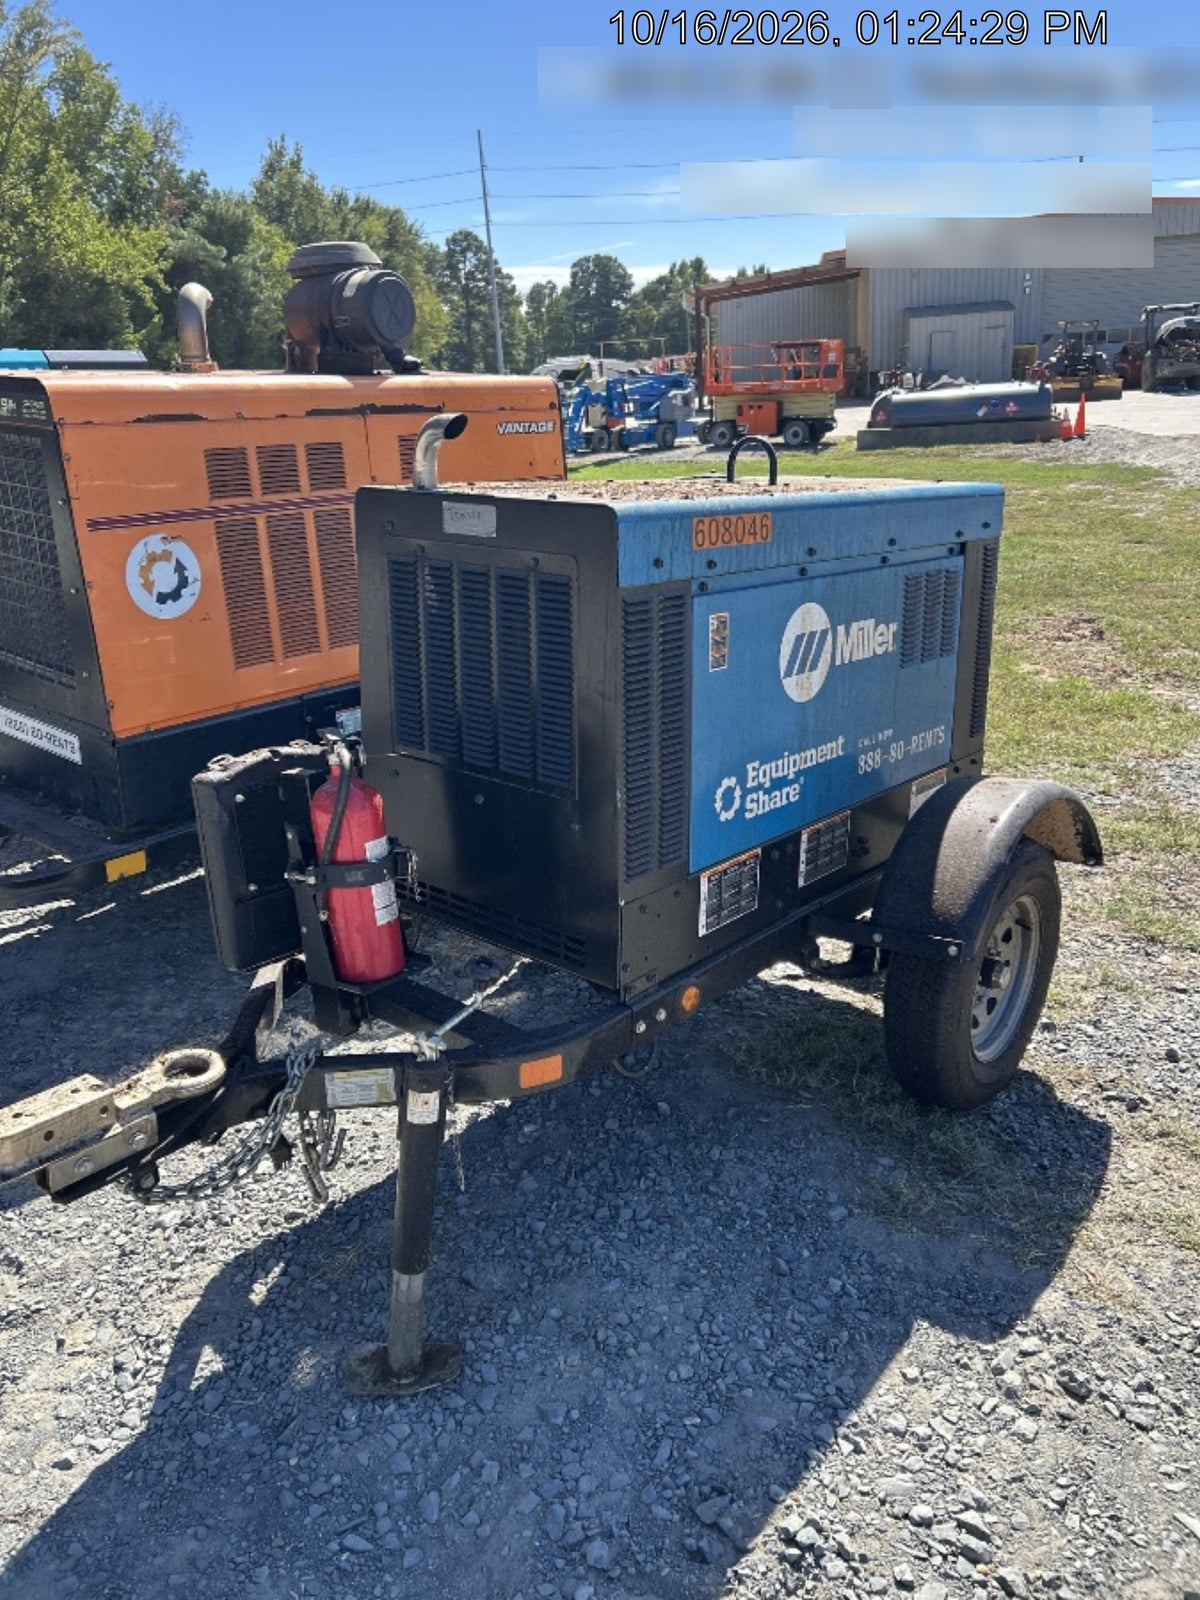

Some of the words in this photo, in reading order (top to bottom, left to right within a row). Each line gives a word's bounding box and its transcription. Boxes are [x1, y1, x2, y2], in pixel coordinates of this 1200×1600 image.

[497, 420, 555, 435] VANTAGE
[694, 513, 769, 548] 608046
[835, 618, 898, 666] Miller
[745, 735, 845, 789] Equipment
[858, 725, 945, 775] 888-80-RENTS
[744, 783, 801, 820] Share
